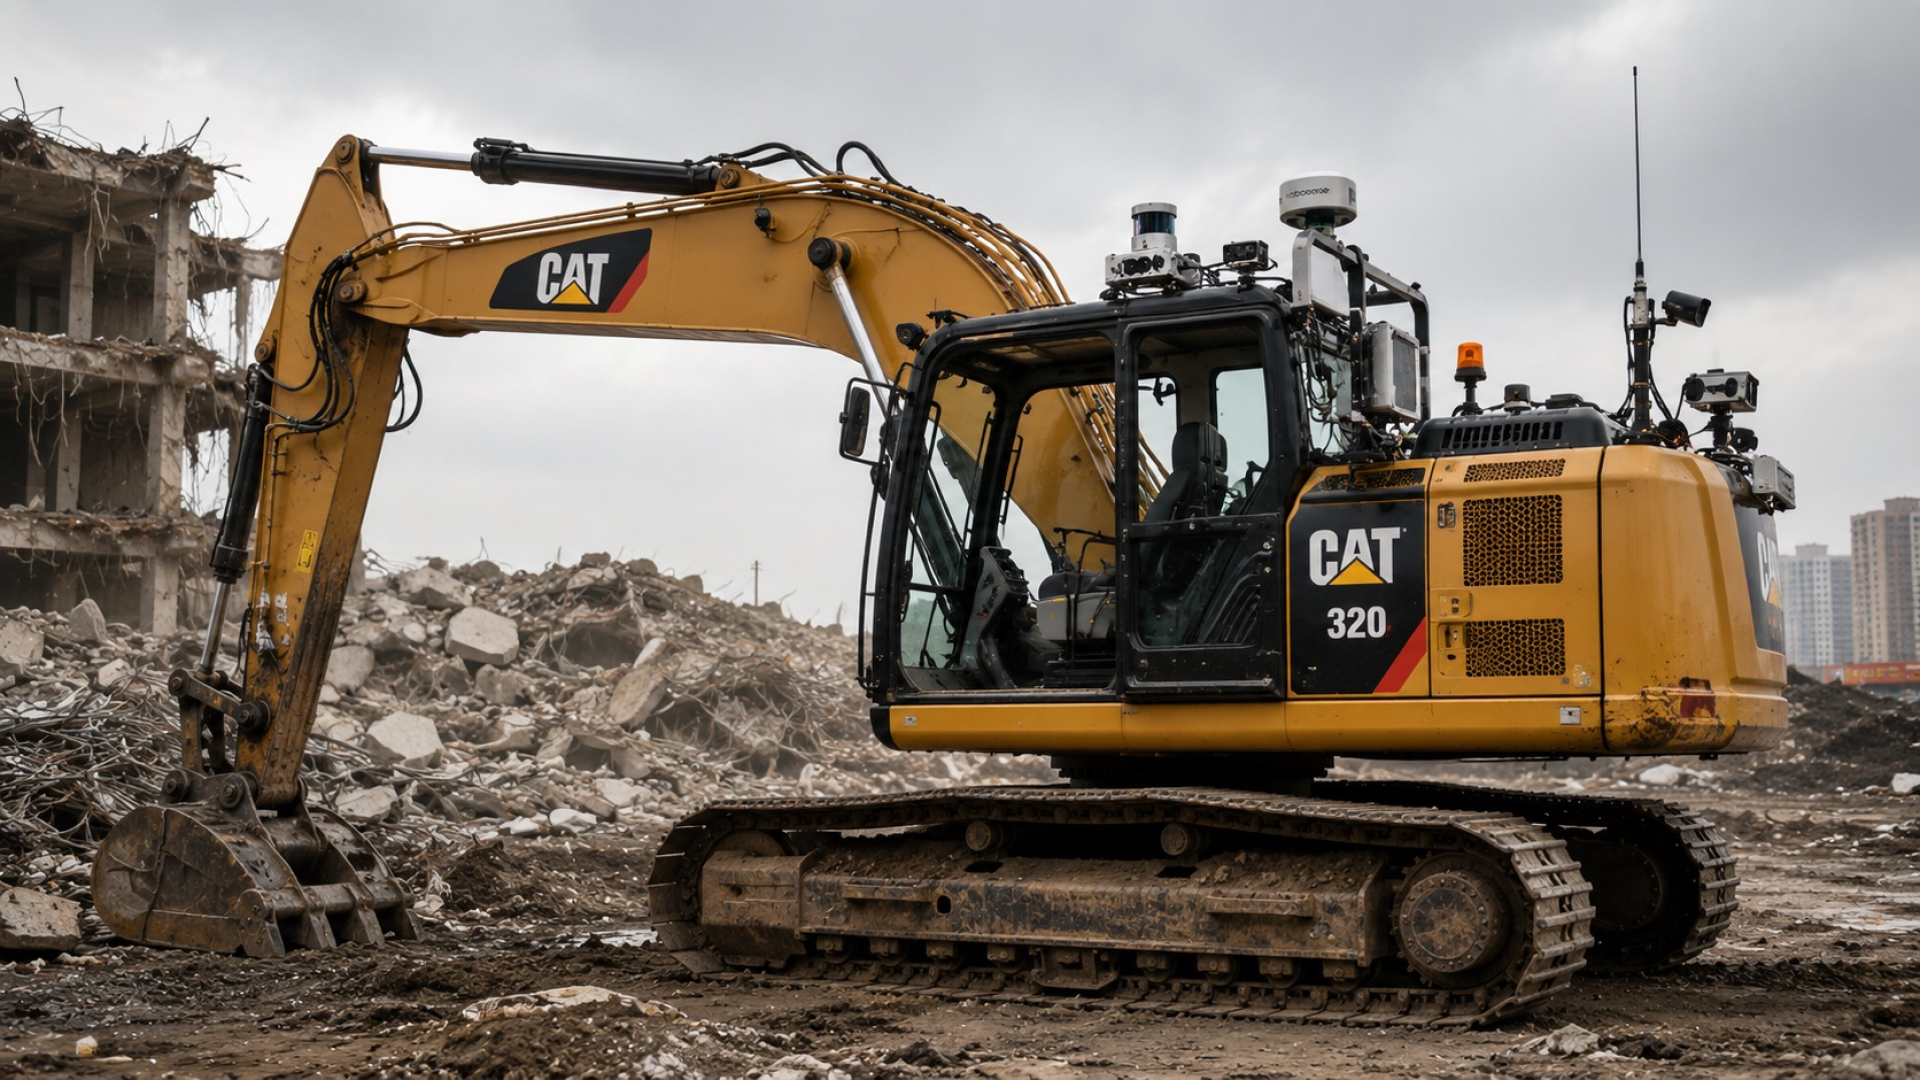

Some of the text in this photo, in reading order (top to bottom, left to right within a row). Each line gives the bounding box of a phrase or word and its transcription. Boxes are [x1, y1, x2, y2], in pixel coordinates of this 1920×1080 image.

[536, 252, 610, 305] CAT
[1309, 526, 1401, 586] CAT
[1327, 605, 1387, 639] 320
